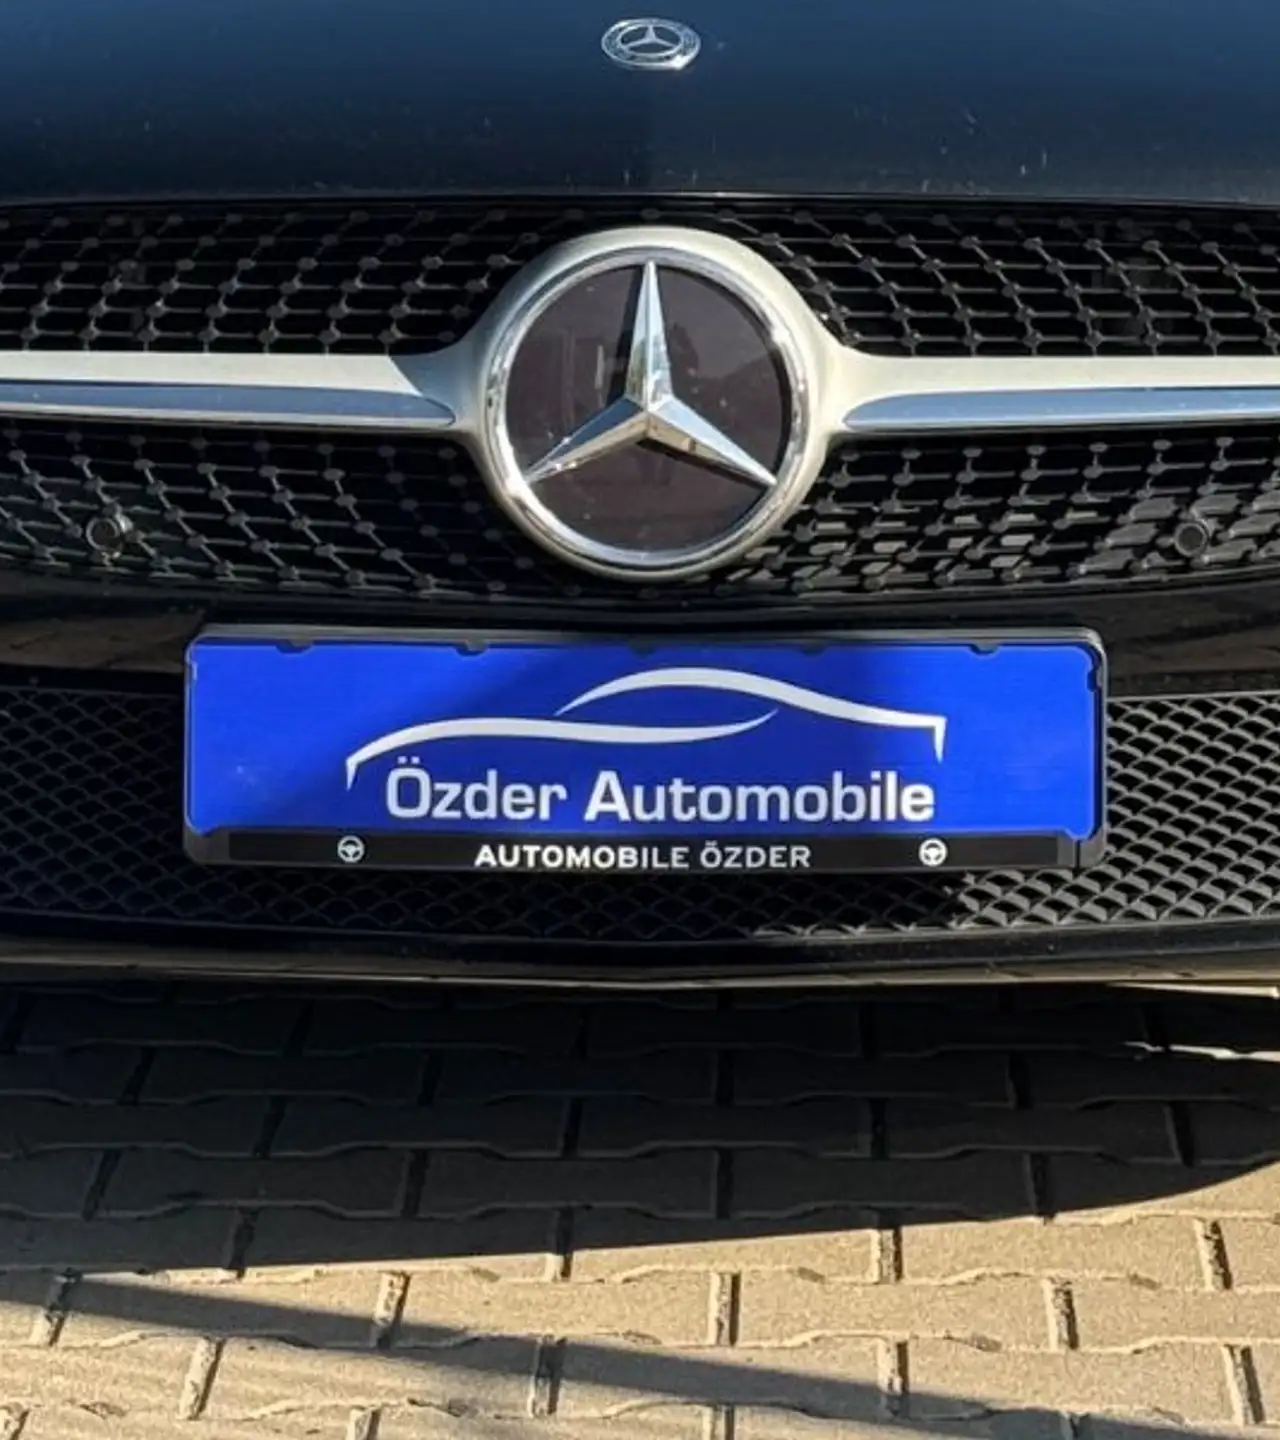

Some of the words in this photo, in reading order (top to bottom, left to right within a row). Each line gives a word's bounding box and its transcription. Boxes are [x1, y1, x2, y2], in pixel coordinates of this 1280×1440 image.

[386, 756, 568, 821] Özder
[583, 769, 936, 822] Automobile
[474, 844, 700, 869] AUTOMOBILE
[700, 839, 812, 869] ÖZDER
